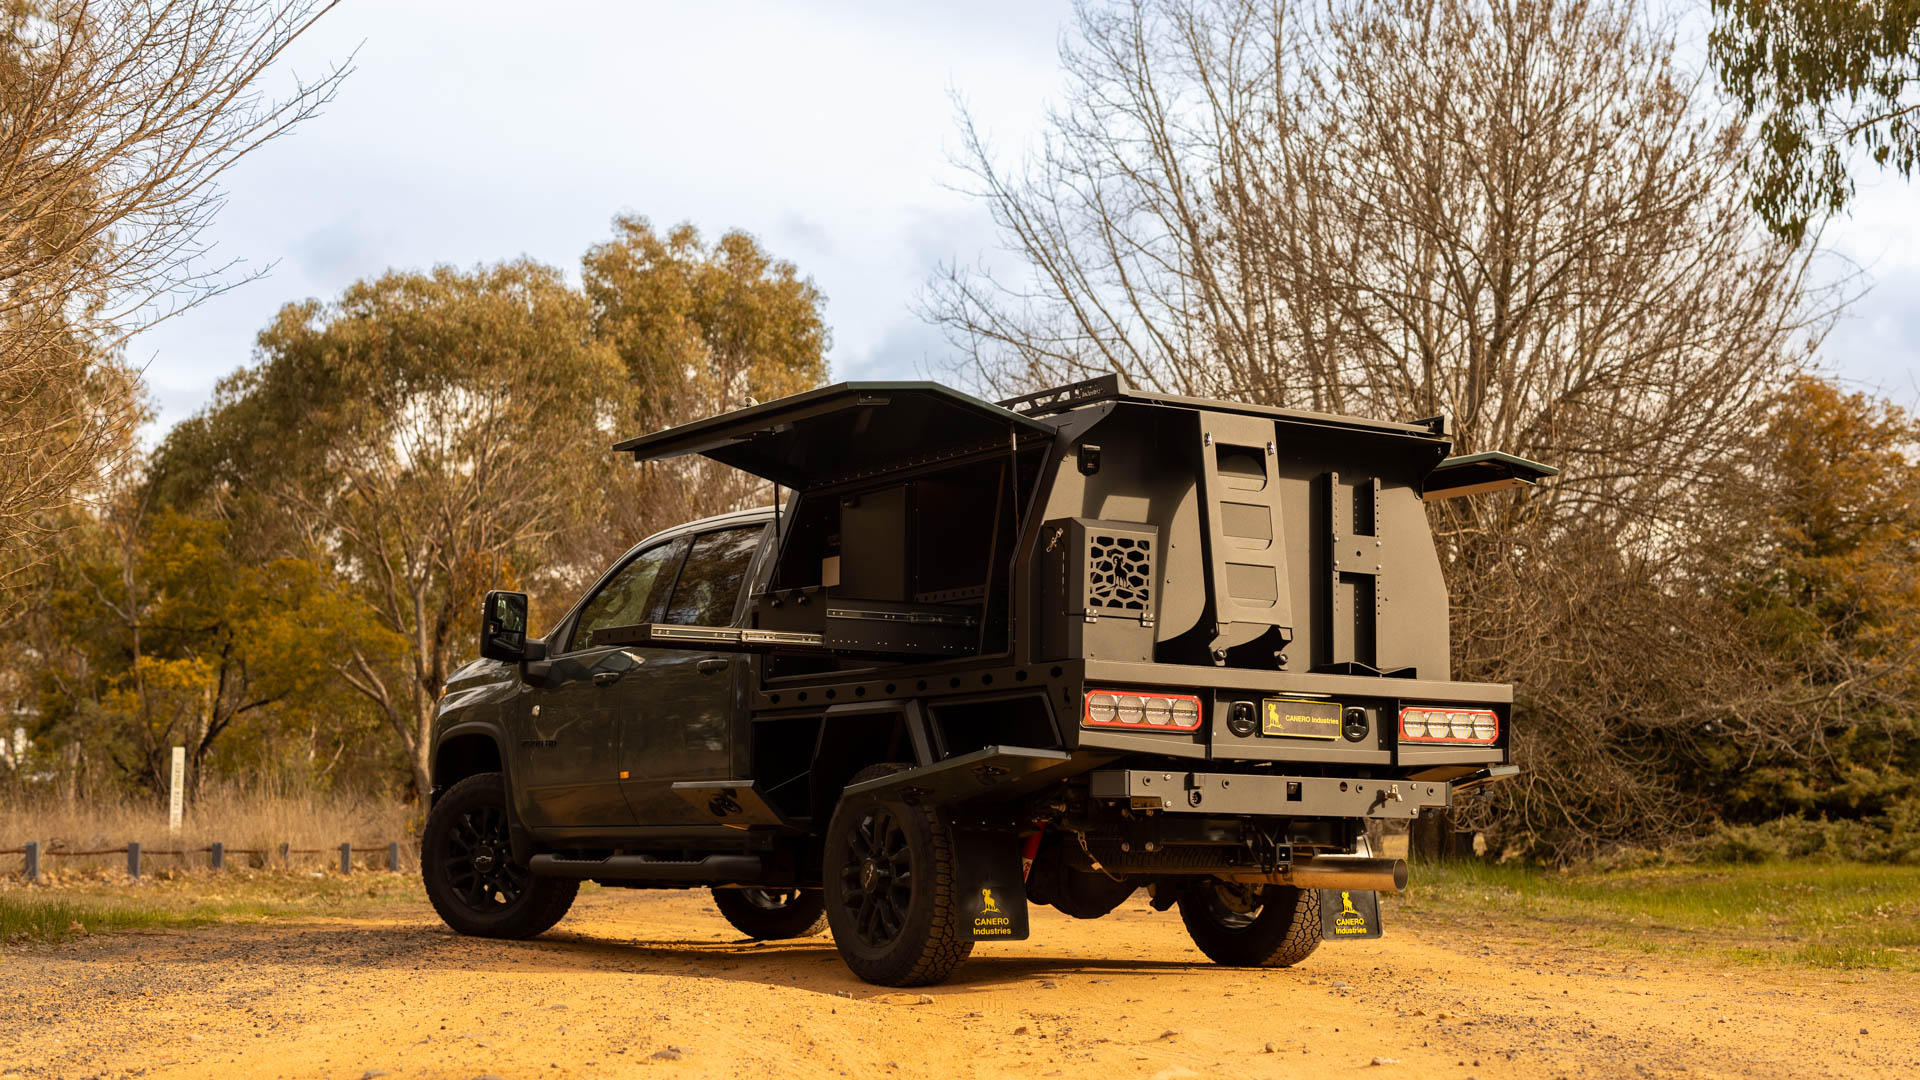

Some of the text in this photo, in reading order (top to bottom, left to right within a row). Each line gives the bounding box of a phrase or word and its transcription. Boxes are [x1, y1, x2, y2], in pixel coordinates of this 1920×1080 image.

[1285, 714, 1339, 725] CANERO Industries
[974, 917, 1009, 926] CANERO
[1335, 917, 1365, 926] CANERO
[973, 927, 1012, 935] Industries
[1335, 927, 1367, 935] Industries
